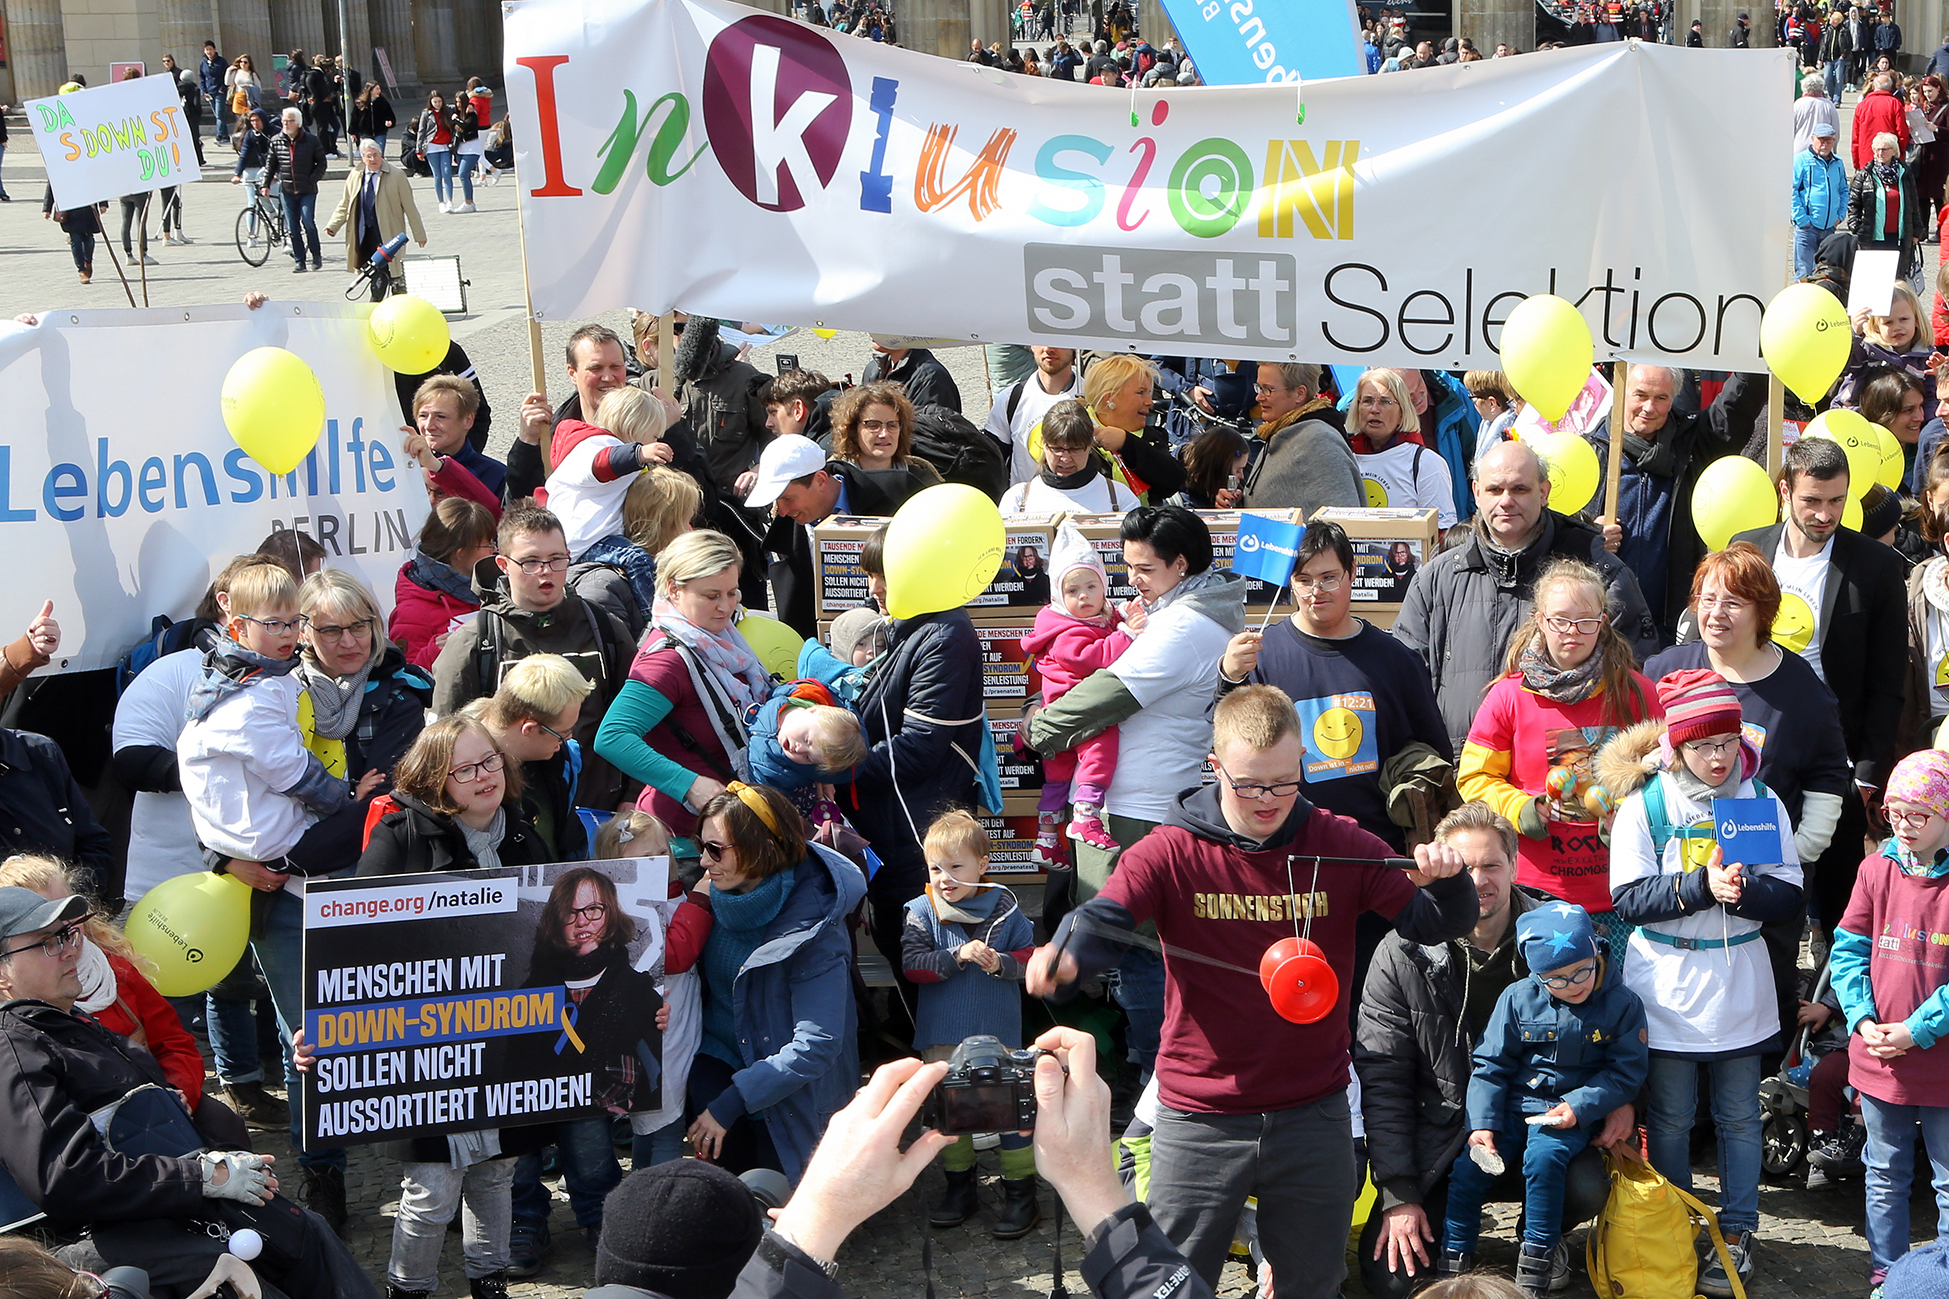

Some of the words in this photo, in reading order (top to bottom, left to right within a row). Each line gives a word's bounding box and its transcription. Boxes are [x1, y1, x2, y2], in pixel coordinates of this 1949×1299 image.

[36, 100, 75, 133] DA
[138, 143, 182, 181] DU!
[1033, 254, 1290, 341] statt
[824, 543, 856, 551] TAUSENDE
[1357, 543, 1369, 553] MIT
[824, 553, 860, 564] MENSCHEN
[1104, 553, 1117, 562] MIT
[824, 576, 848, 586] SOLLEN
[1364, 578, 1395, 588] WERDEN!
[994, 582, 1024, 592] WERDEN!
[988, 630, 1023, 638] MENSCHEN
[989, 652, 1002, 662] AUF
[1333, 697, 1374, 709] #12:21
[996, 732, 1008, 742] MIT
[1004, 765, 1035, 775] WERDEN!
[1308, 763, 1328, 773] Down
[1328, 762, 1337, 770] ist
[1348, 764, 1364, 773] nicht
[991, 818, 1005, 828] DEN
[1737, 822, 1777, 832] Lebenshilfe
[1002, 829, 1016, 839] AUF
[320, 895, 424, 918] change.org
[427, 887, 503, 911] /natalie
[147, 912, 188, 951] Lebenshilfe
[317, 958, 452, 1003] MENSCHEN
[460, 953, 506, 987] MIT
[318, 992, 554, 1048] DOWN-SYNDROM
[317, 1051, 406, 1093] SOLLEN
[414, 1042, 486, 1082] NICHT
[317, 1087, 478, 1138] AUSSORTIERT
[485, 1072, 593, 1118] WERDEN!
